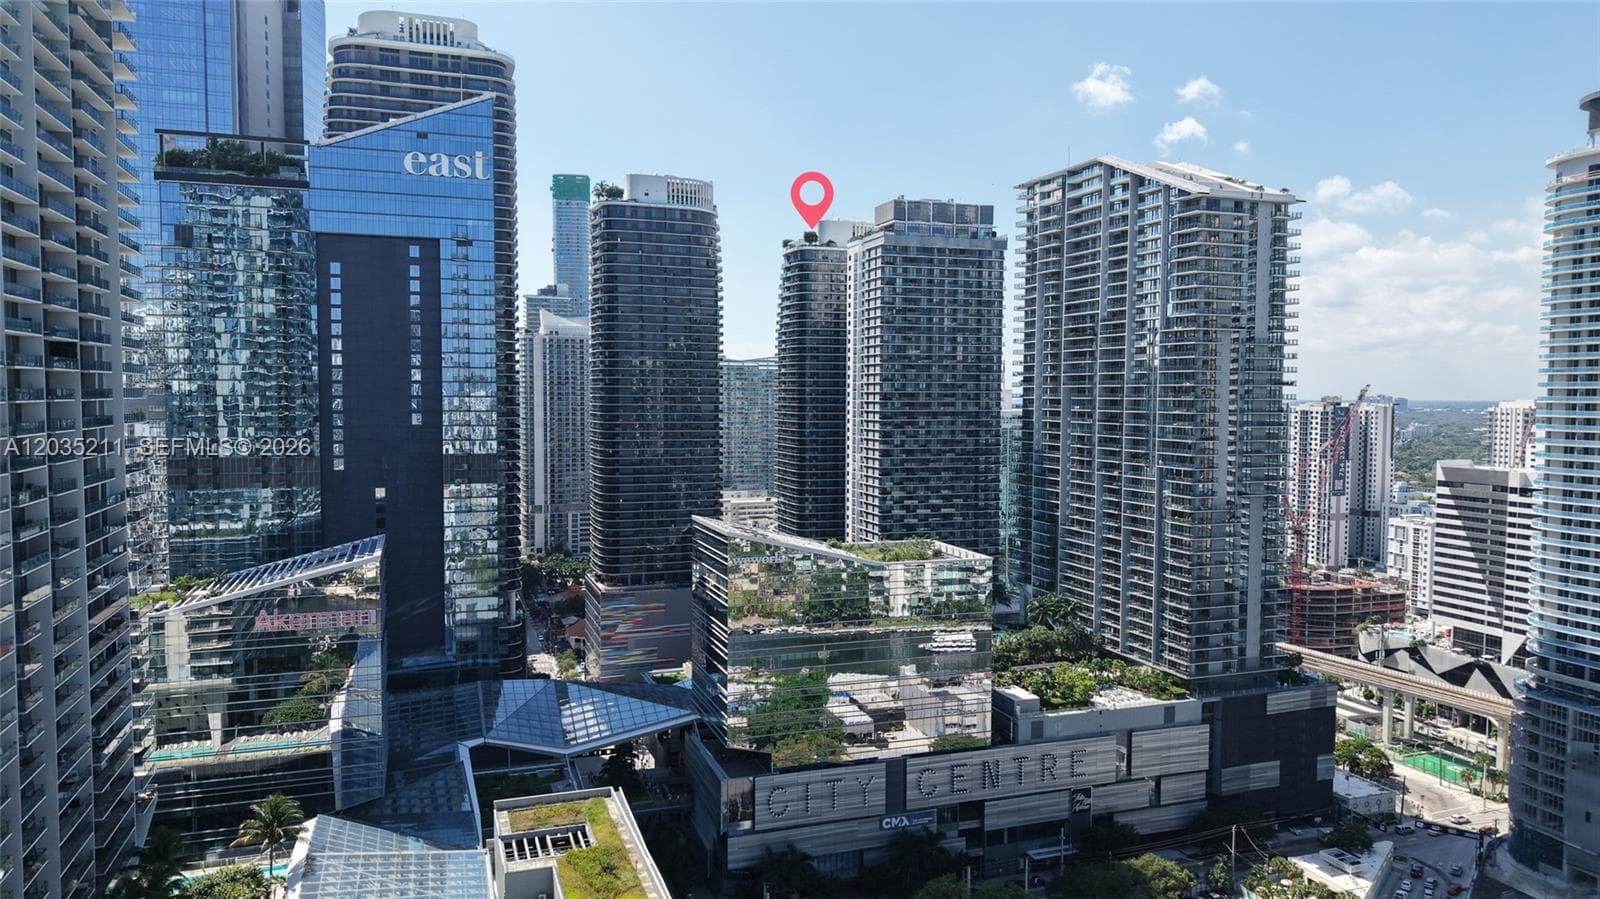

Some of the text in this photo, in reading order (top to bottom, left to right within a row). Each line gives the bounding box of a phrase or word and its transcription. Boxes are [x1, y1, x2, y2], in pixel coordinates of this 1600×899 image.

[403, 150, 490, 180] east
[250, 608, 372, 633] Akerman
[768, 749, 1089, 818] CITY CENTRE
